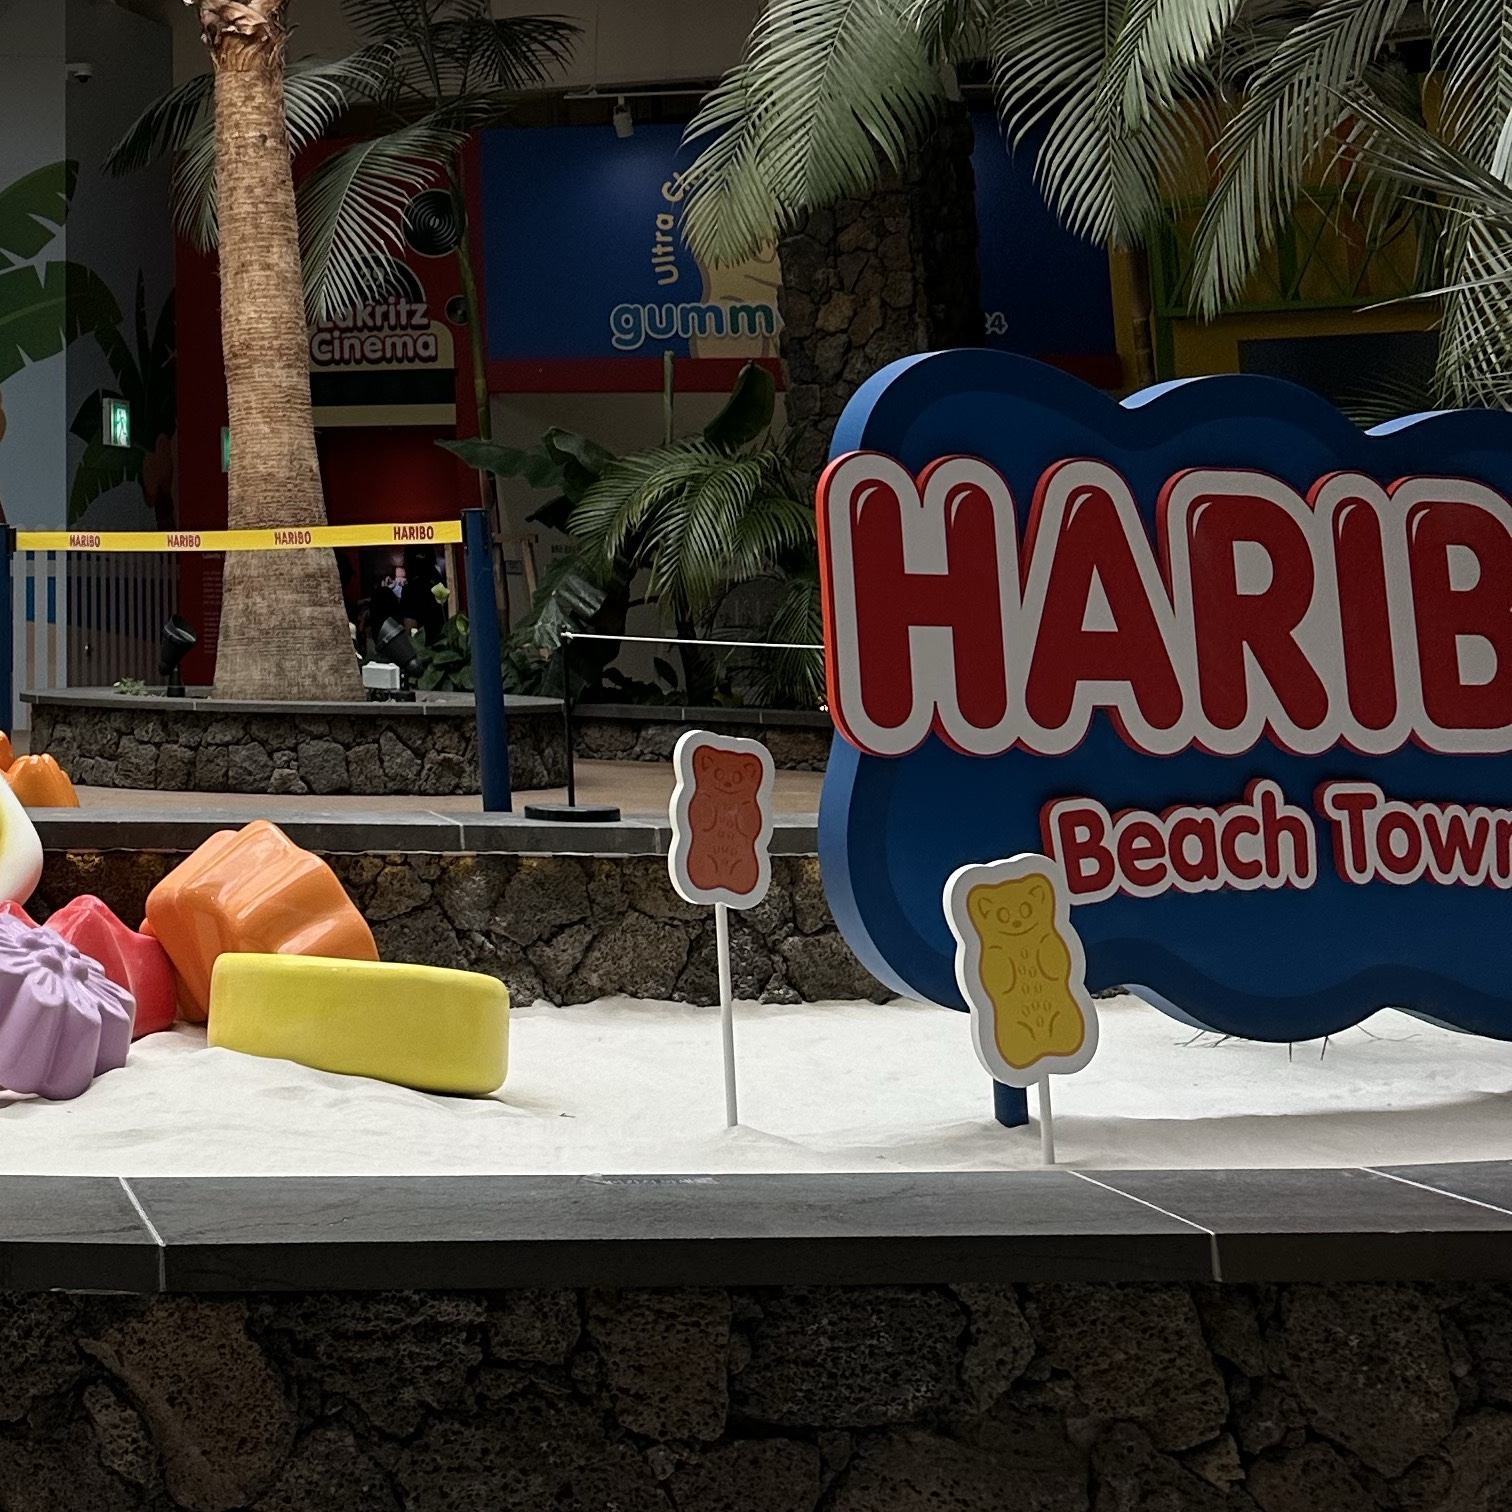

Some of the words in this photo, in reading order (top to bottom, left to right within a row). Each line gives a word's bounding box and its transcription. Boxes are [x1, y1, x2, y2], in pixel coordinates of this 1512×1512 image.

[651, 213, 679, 285] Ultra
[610, 302, 779, 350] gumm
[310, 332, 437, 363] Cinema
[69, 534, 101, 548] HARIBO
[167, 534, 201, 548] HARIBO
[274, 531, 312, 545] HARIBO
[393, 525, 434, 540] HARIBO
[1050, 784, 1314, 899] Beach
